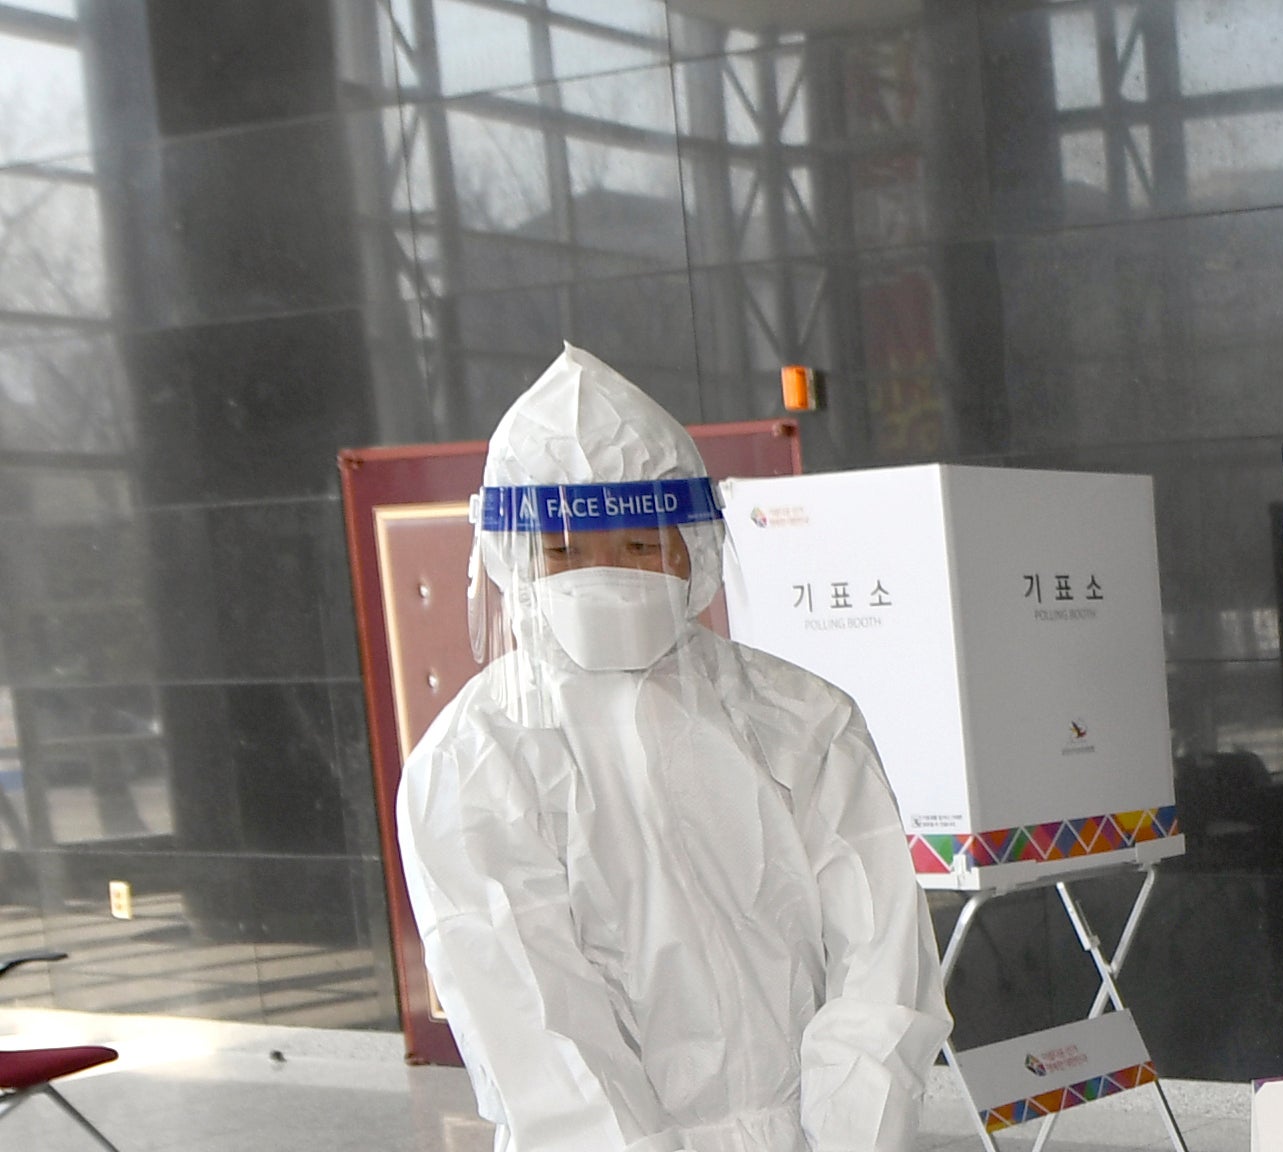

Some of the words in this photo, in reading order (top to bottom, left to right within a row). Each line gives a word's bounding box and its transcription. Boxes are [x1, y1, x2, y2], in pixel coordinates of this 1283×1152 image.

[546, 498, 600, 518] FACE
[605, 493, 678, 516] SHIELD
[792, 578, 893, 613] 기표소
[1023, 573, 1104, 604] 기표소
[804, 617, 846, 631] POLLING
[847, 615, 882, 629] BOOTH
